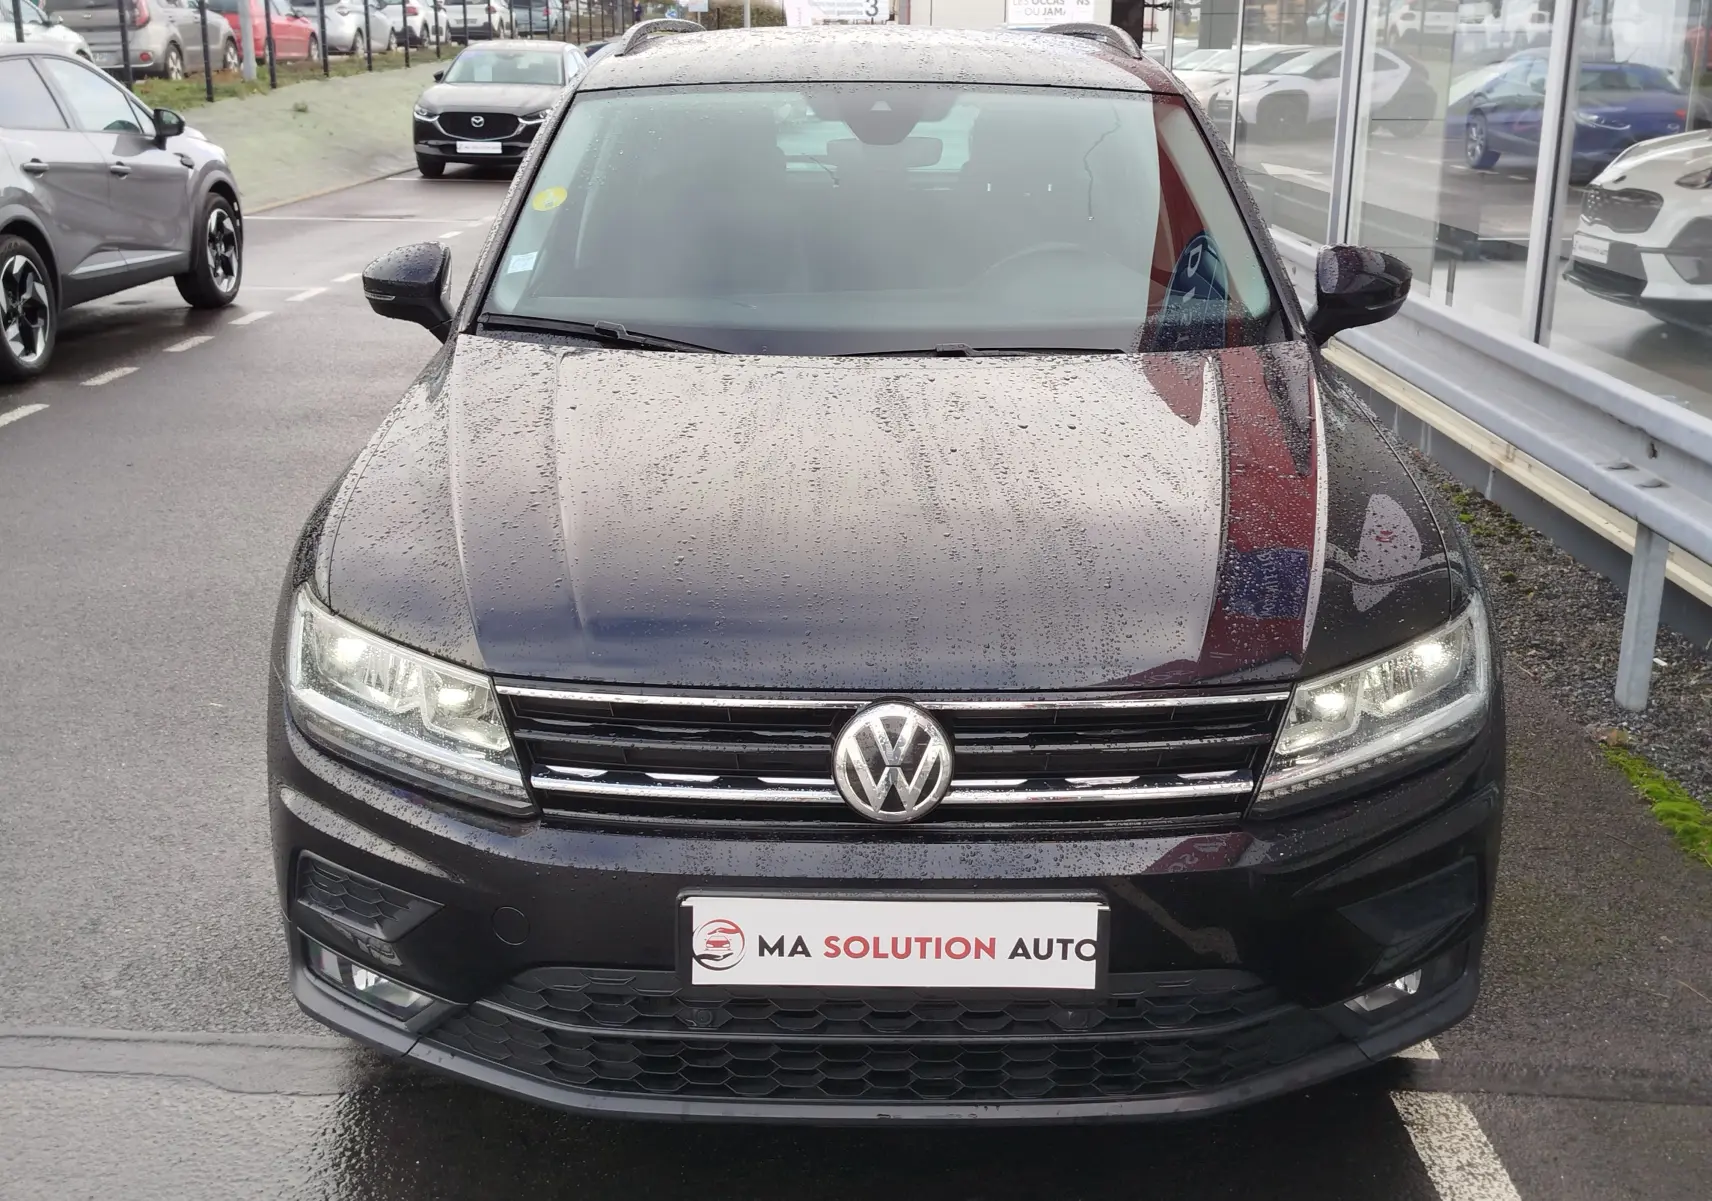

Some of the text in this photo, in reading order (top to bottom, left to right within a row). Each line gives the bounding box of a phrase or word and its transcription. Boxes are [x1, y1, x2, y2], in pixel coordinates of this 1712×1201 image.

[865, 0, 879, 17] 3
[758, 934, 1097, 962] MA SOLUTION AUTO
